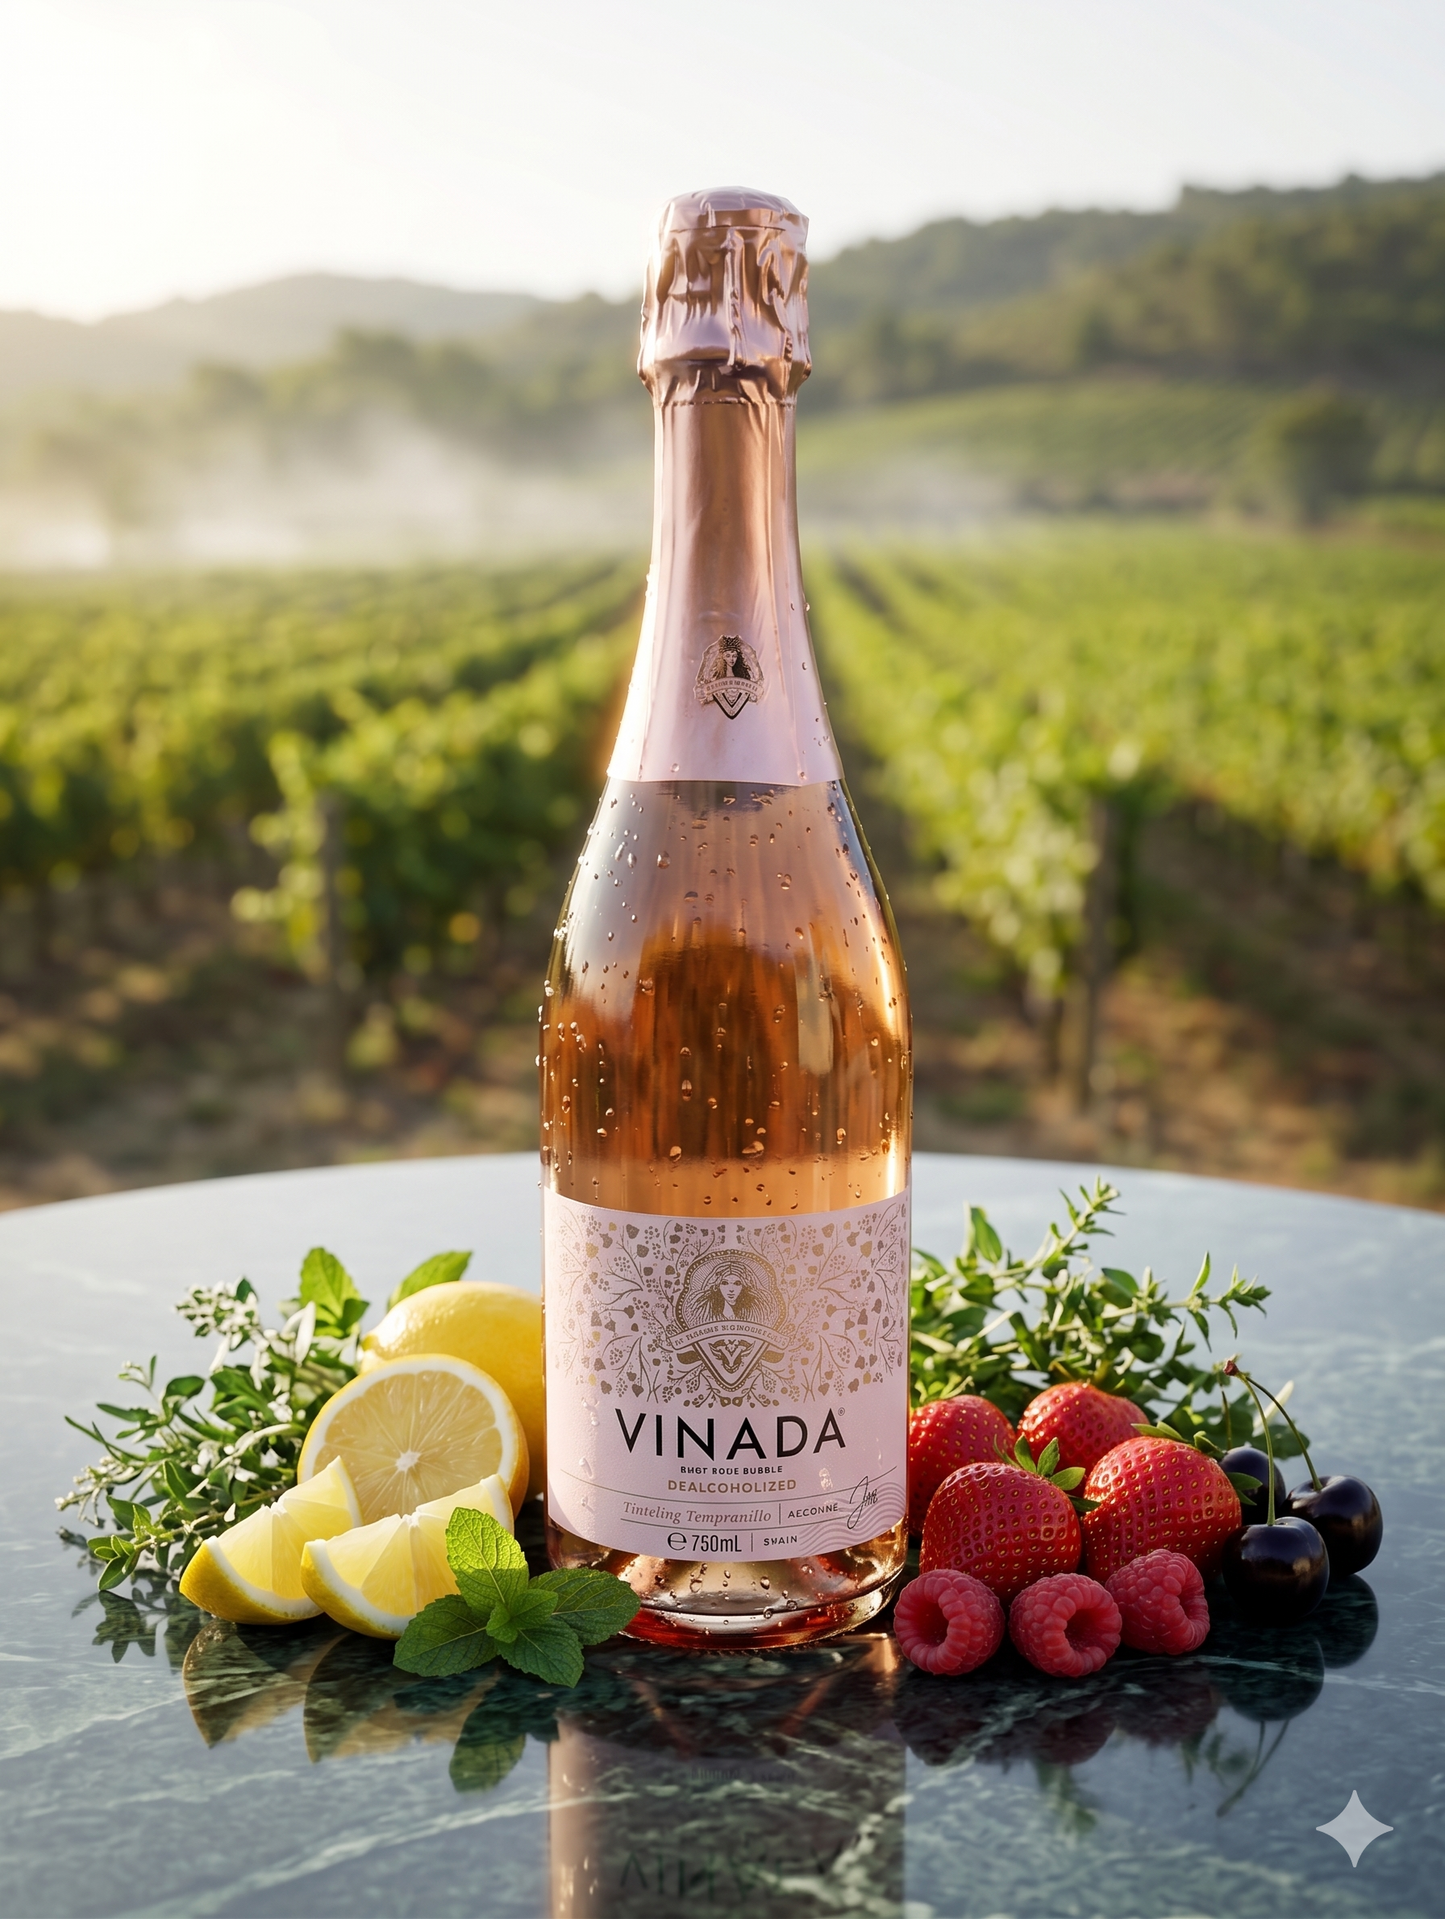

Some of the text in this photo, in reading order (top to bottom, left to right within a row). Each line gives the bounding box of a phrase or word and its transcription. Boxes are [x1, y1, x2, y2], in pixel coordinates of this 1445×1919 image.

[743, 1465, 783, 1475] BUBBLE
[668, 1479, 797, 1494] DEALCOHOLIZED
[623, 1501, 839, 1527] Tinteling Tempranillo AECONNE
[691, 1534, 742, 1553] 750mL
